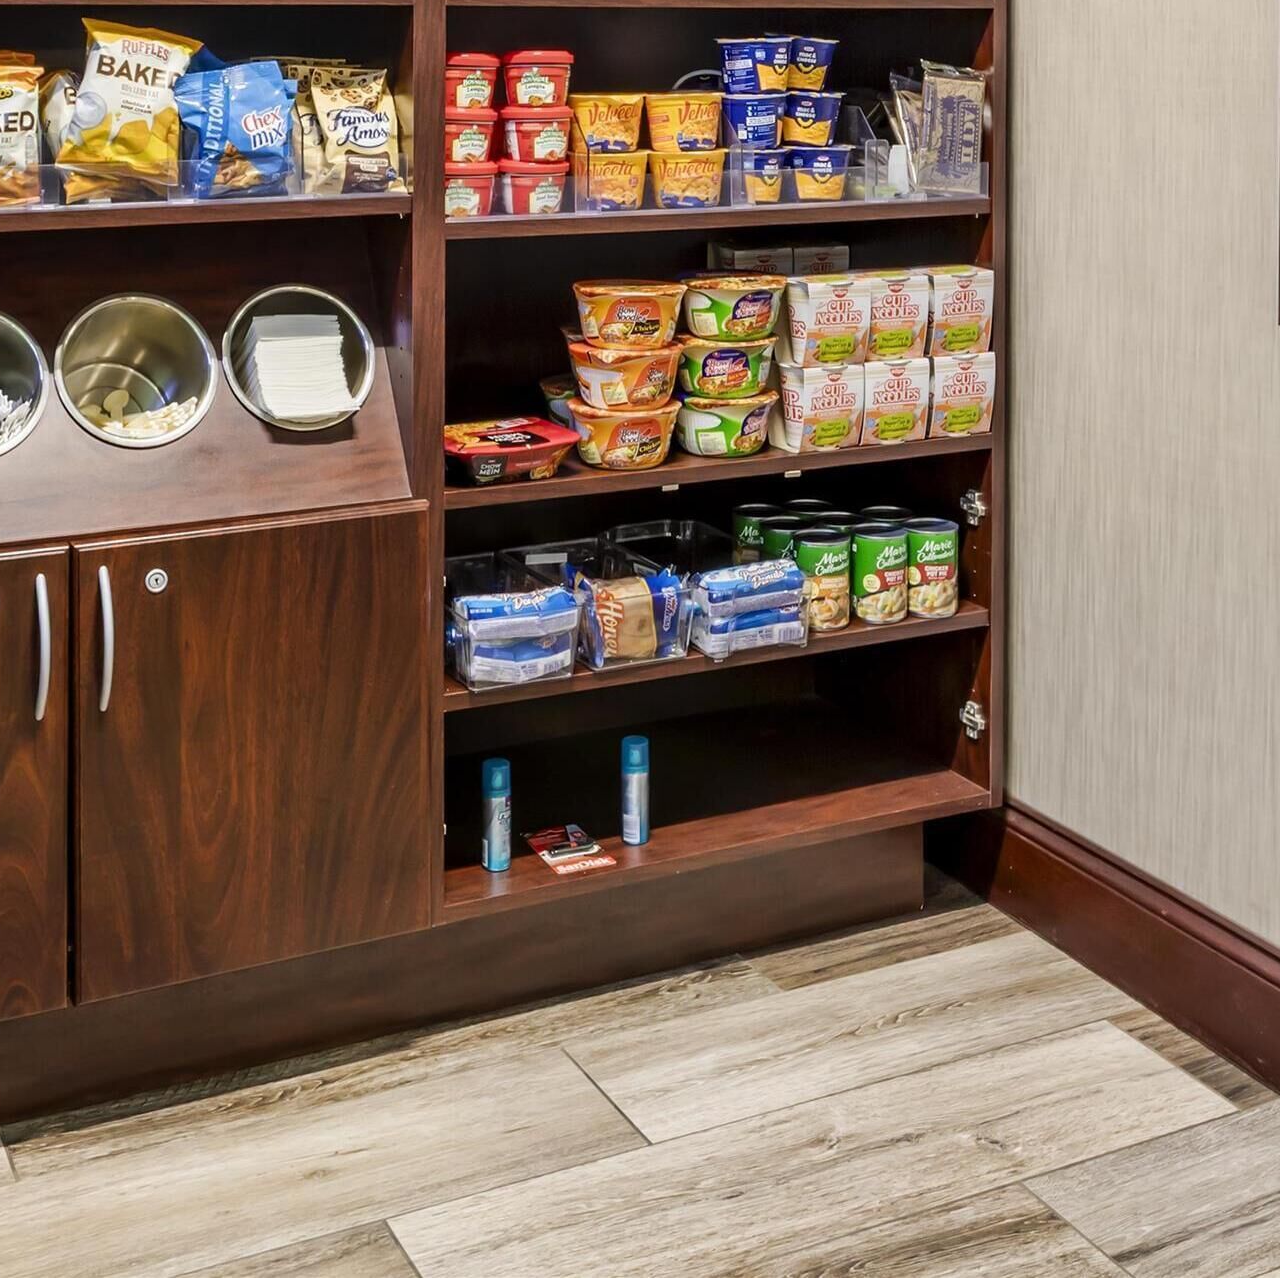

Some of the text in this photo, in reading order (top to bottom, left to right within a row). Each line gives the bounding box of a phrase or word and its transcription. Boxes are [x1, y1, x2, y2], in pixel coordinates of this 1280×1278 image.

[121, 38, 170, 63] RUFFLES
[242, 106, 281, 134] Chex
[326, 108, 390, 131] Famous
[0, 137, 13, 146] FAT
[336, 126, 389, 147] Amos
[659, 158, 716, 178] Velveeta
[882, 294, 911, 308] CUP
[952, 289, 978, 304] CUP
[826, 299, 854, 313] CUP
[871, 304, 920, 321] NOODLES
[941, 300, 985, 316] NOODLES
[815, 310, 862, 326] NOODLES
[633, 323, 659, 332] Chicken
[883, 378, 912, 392] CUP
[952, 372, 979, 386] CUP
[821, 383, 848, 398] CUP
[872, 387, 921, 405] NOODLES
[942, 381, 987, 398] NOODLES
[810, 393, 856, 411] NOODLES
[639, 443, 661, 453] Chicken
[479, 468, 500, 476] MEIN
[917, 540, 953, 554] Marie
[816, 551, 849, 566] Marie
[751, 569, 785, 590] Donuts
[556, 857, 613, 874] SanDisk
